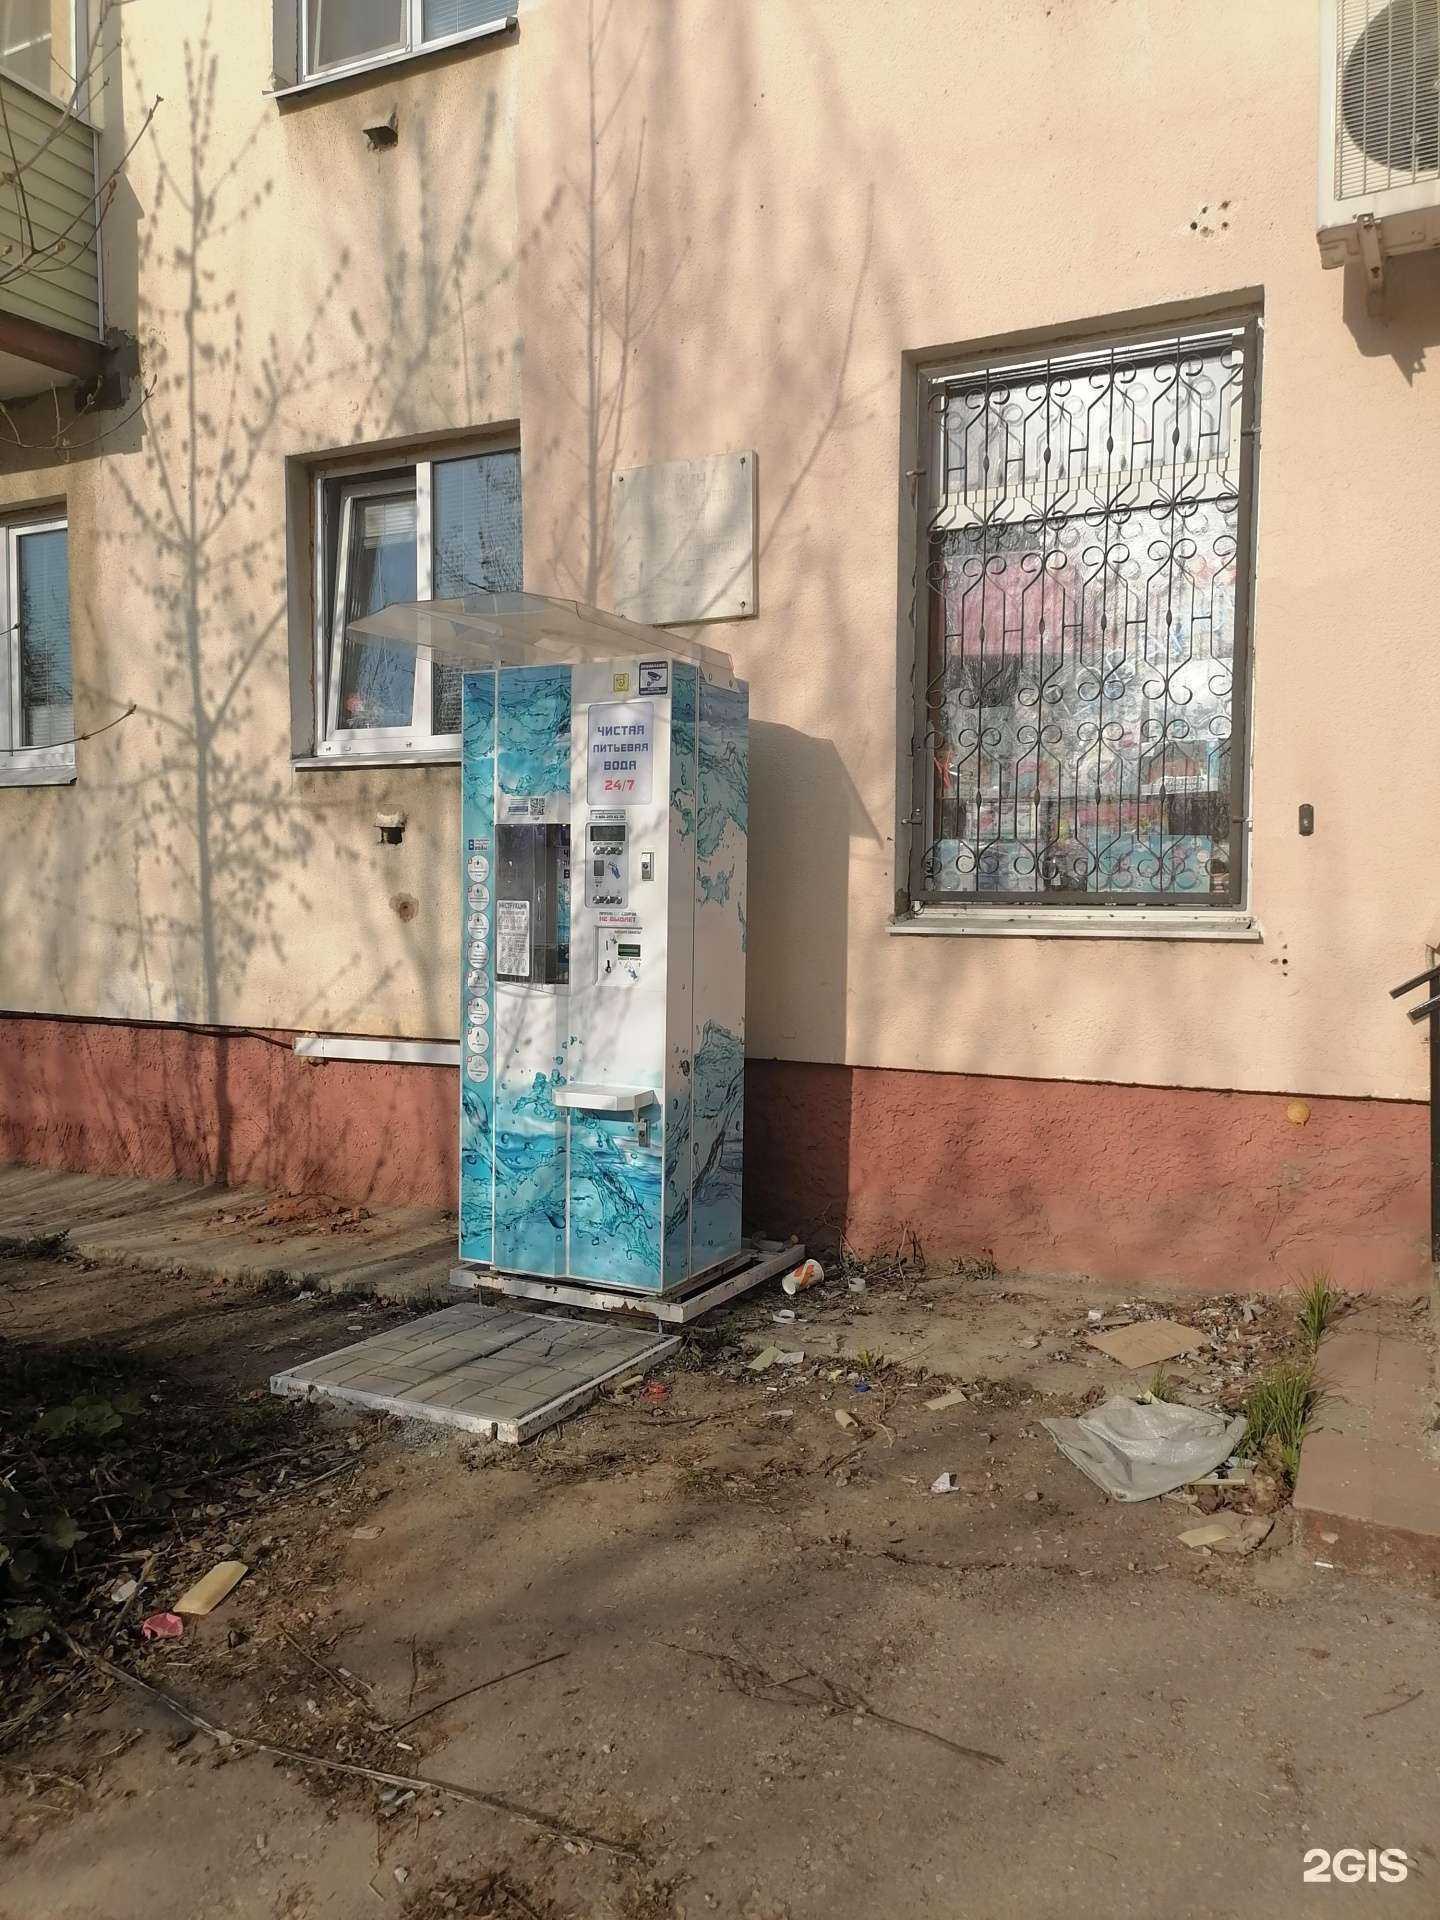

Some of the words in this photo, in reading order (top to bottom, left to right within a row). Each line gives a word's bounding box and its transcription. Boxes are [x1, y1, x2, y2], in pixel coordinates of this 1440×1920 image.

[597, 725, 645, 736] ЧИСТАЯ
[593, 743, 649, 753] ПИТЬЕВАЯ
[603, 760, 637, 771] ВОДА
[604, 779, 636, 792] 24/7
